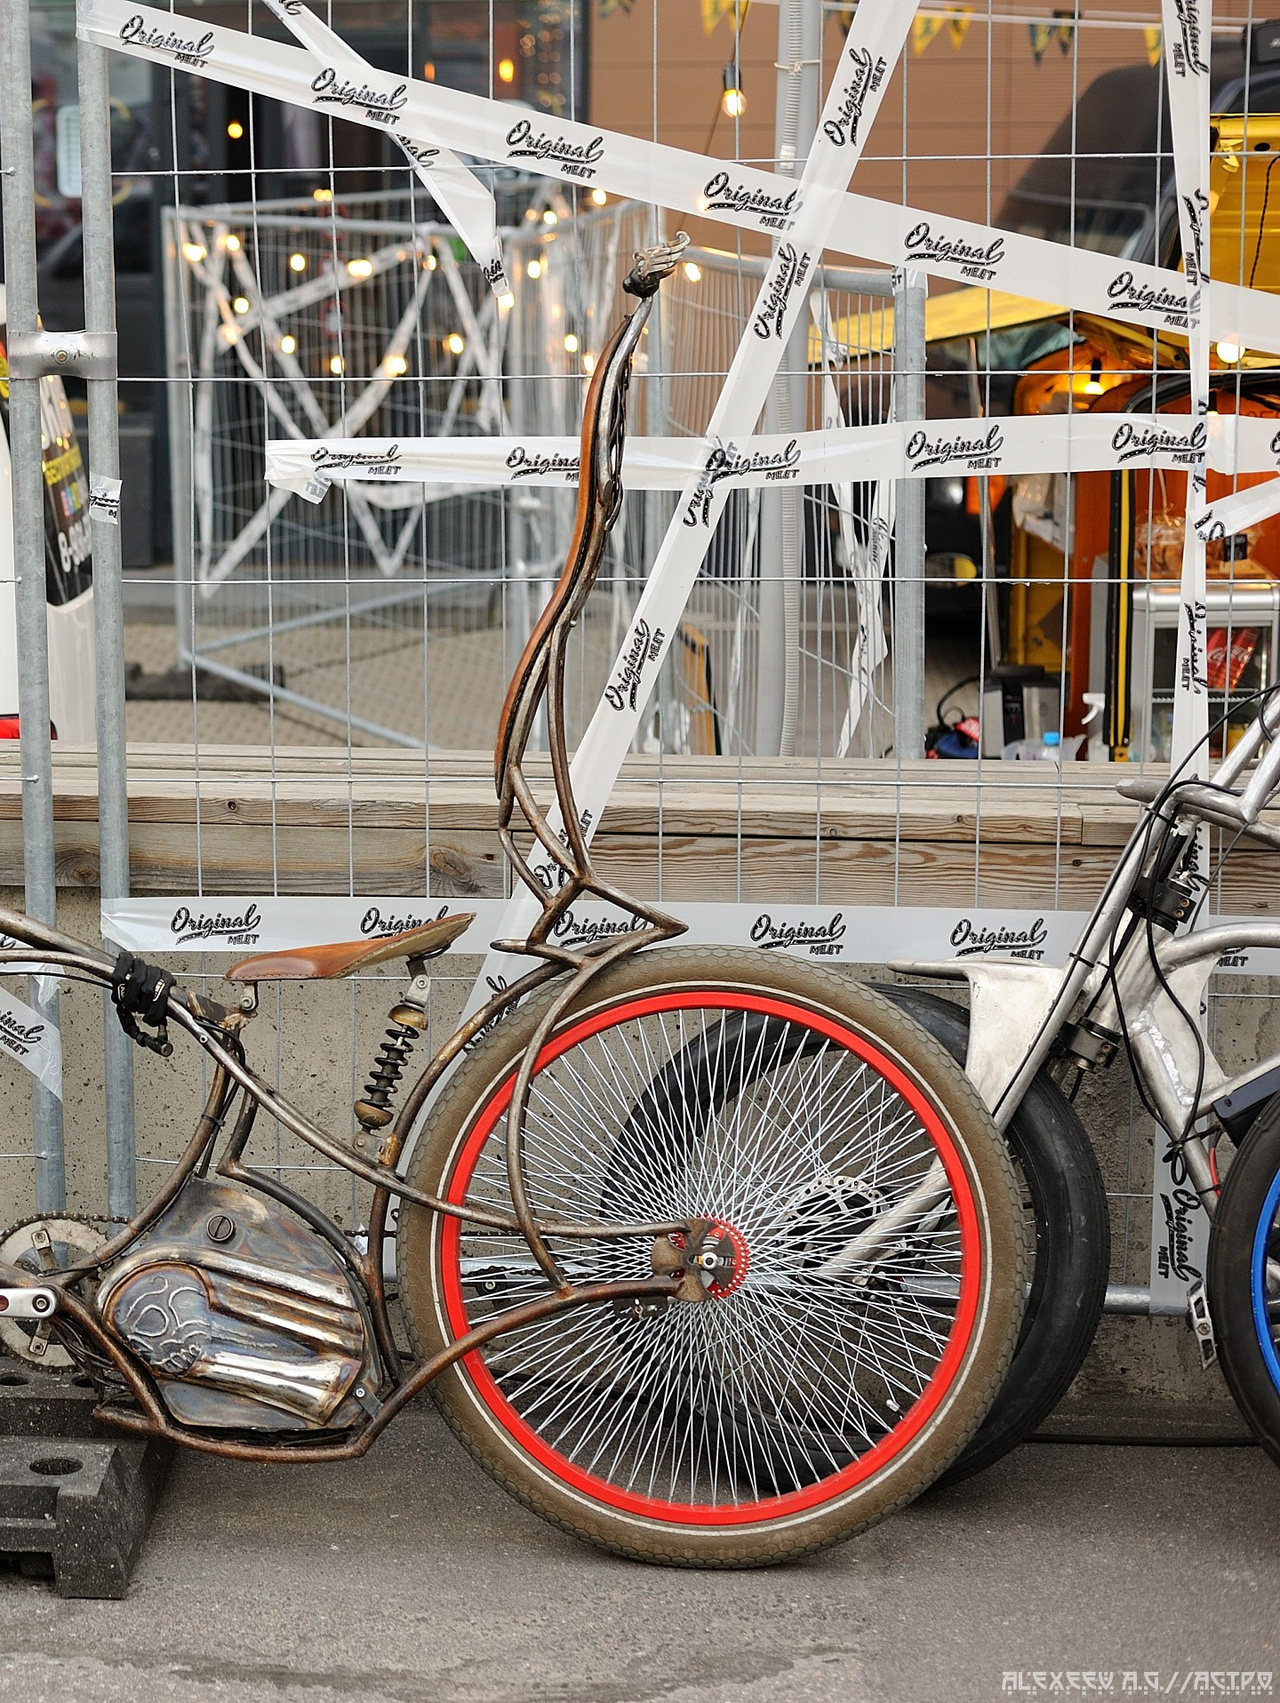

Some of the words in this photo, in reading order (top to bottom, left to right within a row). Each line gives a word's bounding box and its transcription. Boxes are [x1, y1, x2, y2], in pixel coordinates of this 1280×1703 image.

[120, 15, 214, 57] Original
[174, 53, 208, 68] MEET
[870, 57, 887, 93] MEET
[1173, 42, 1186, 78] MEET
[311, 68, 408, 110] Original
[823, 47, 872, 147] Original
[365, 110, 400, 125] MEET
[506, 120, 604, 164] Original
[561, 164, 596, 178] MEET
[704, 172, 803, 216] Original
[759, 216, 796, 232] MEET
[904, 222, 1004, 265] Original
[794, 252, 811, 287] MEET
[960, 265, 997, 281] MEET
[754, 242, 797, 340] Original
[906, 424, 1004, 471] Original
[1111, 422, 1207, 463] Original
[368, 465, 402, 477] MEET
[505, 446, 580, 480] Origina
[706, 439, 801, 485] Original
[766, 469, 800, 480] MEET
[967, 457, 1001, 470] MEET
[648, 628, 665, 662] MEET
[605, 618, 651, 712] Original
[581, 809, 593, 837] EET
[171, 904, 261, 945] Original
[227, 934, 260, 945] MEET
[750, 913, 847, 949] Original
[949, 918, 1048, 957] Original
[809, 944, 844, 955] MEET
[0, 1034, 30, 1056] MEET
[1160, 1189, 1202, 1282] Original
[1158, 1246, 1169, 1279] MEET
